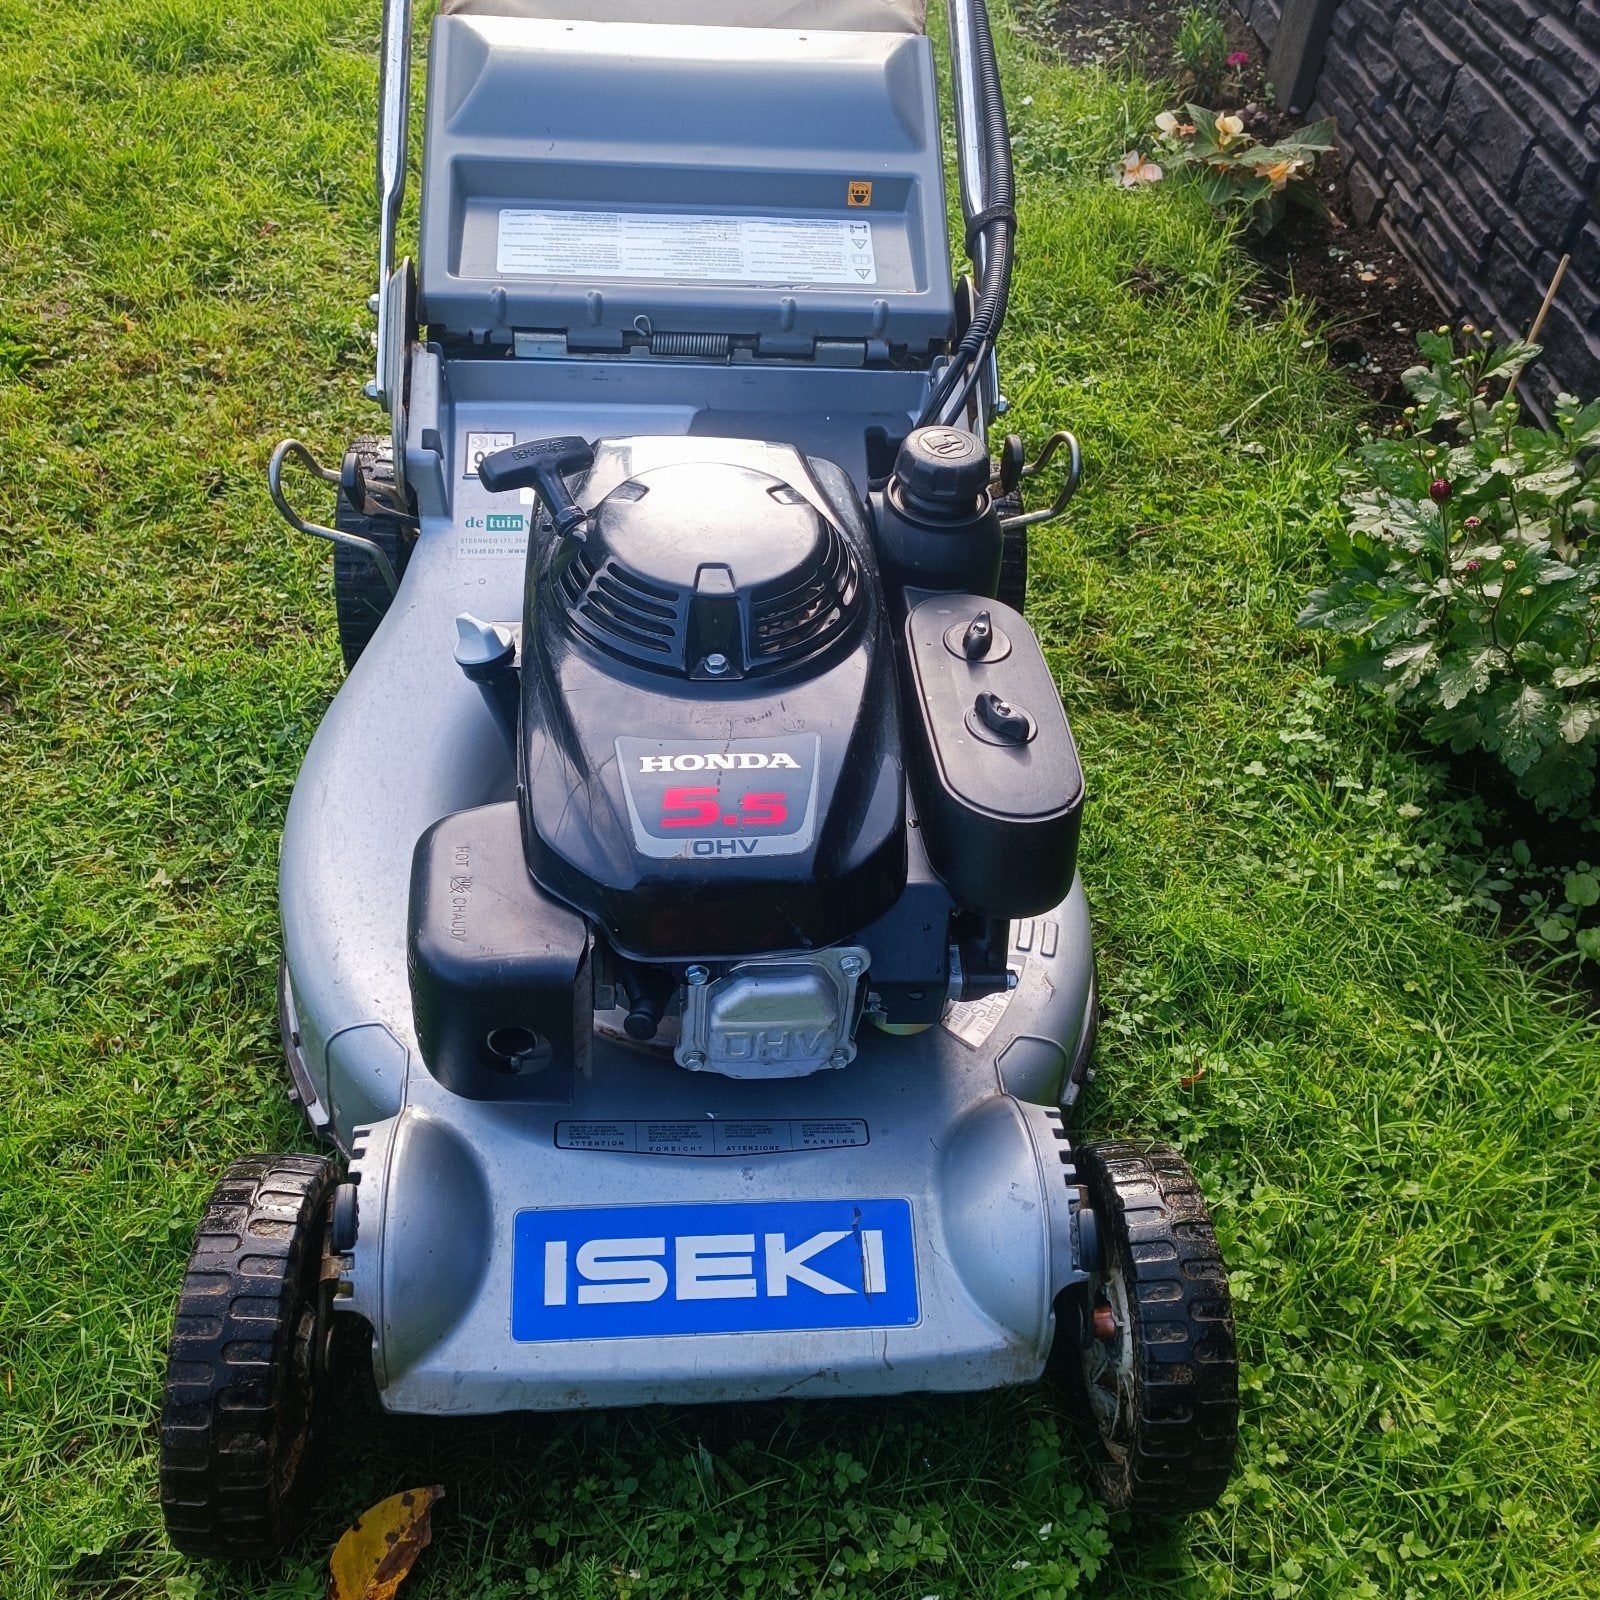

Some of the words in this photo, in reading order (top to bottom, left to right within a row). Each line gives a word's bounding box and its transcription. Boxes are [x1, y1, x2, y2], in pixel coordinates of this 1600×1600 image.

[465, 516, 484, 528] de
[639, 752, 801, 773] HONDA
[661, 786, 788, 828] 5.5
[455, 846, 470, 867] HOT
[692, 838, 759, 856] OHV
[722, 1028, 827, 1058] OHV
[544, 1229, 887, 1306] ISEKI
